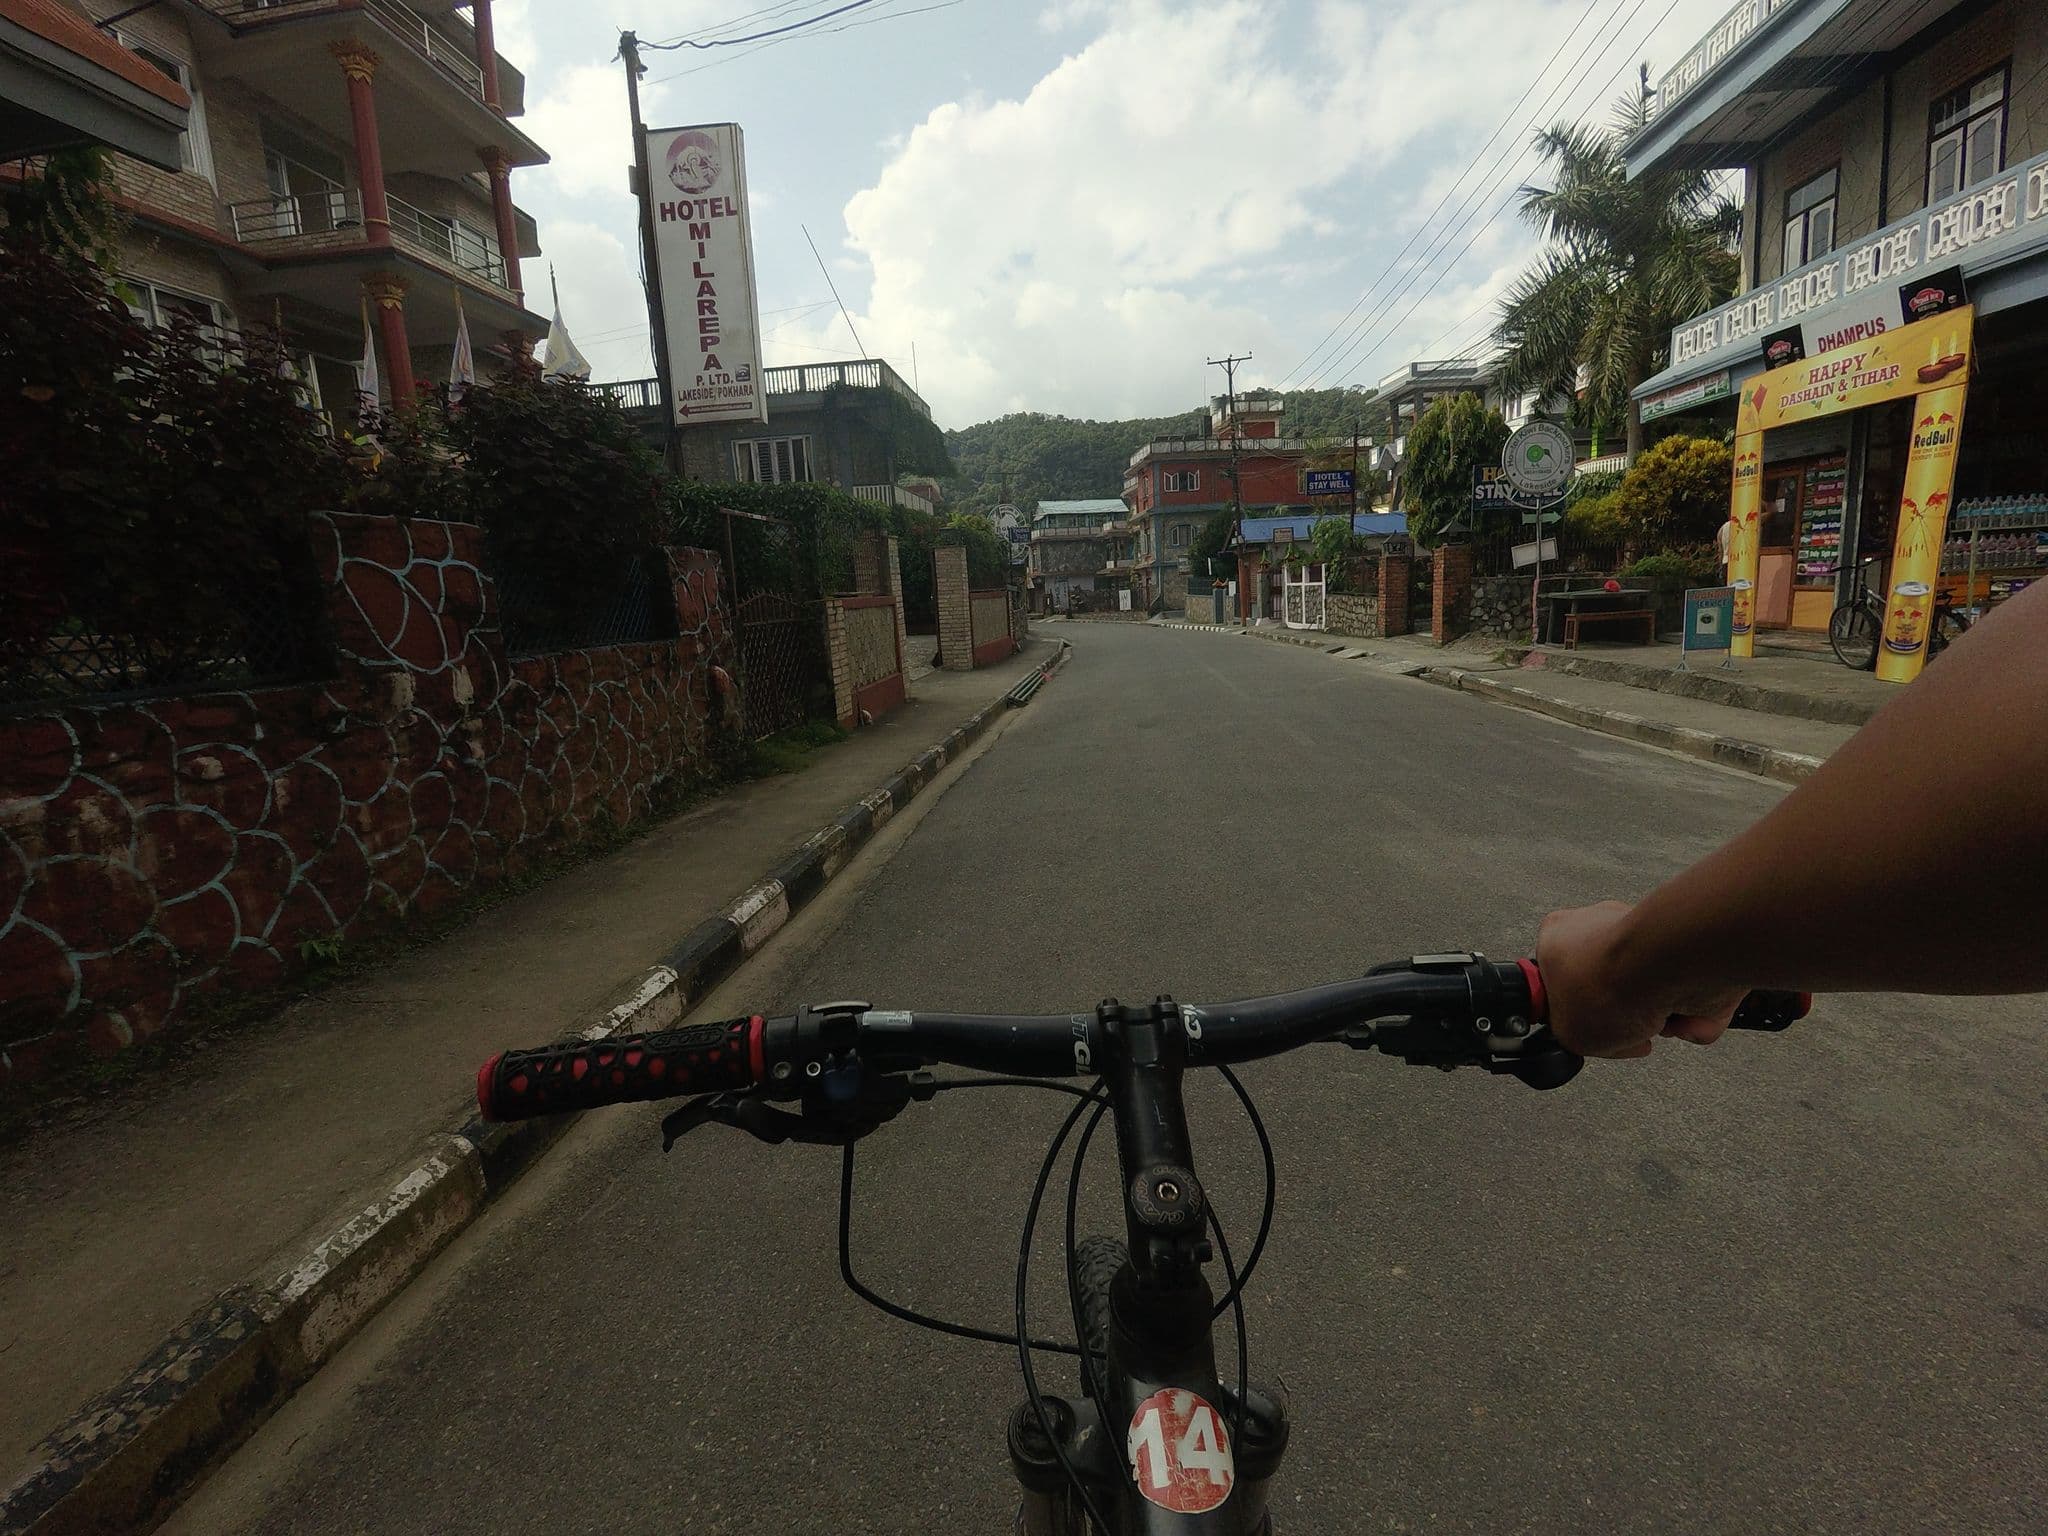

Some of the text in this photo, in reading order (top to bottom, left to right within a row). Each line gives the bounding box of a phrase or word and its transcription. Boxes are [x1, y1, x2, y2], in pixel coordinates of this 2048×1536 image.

[660, 196, 737, 222] HOTEL
[689, 222, 722, 371] MILAREPA
[1818, 317, 1886, 353] DHAMPUS
[709, 373, 734, 385] LTD.
[1807, 353, 1867, 385] HAPPY
[718, 384, 754, 398] POKHARA
[1780, 364, 1900, 408] DASHAIN & TIHAR
[1309, 480, 1350, 490] STAY WELL
[1475, 484, 1512, 499] STAY
[1130, 1406, 1229, 1488] 14
